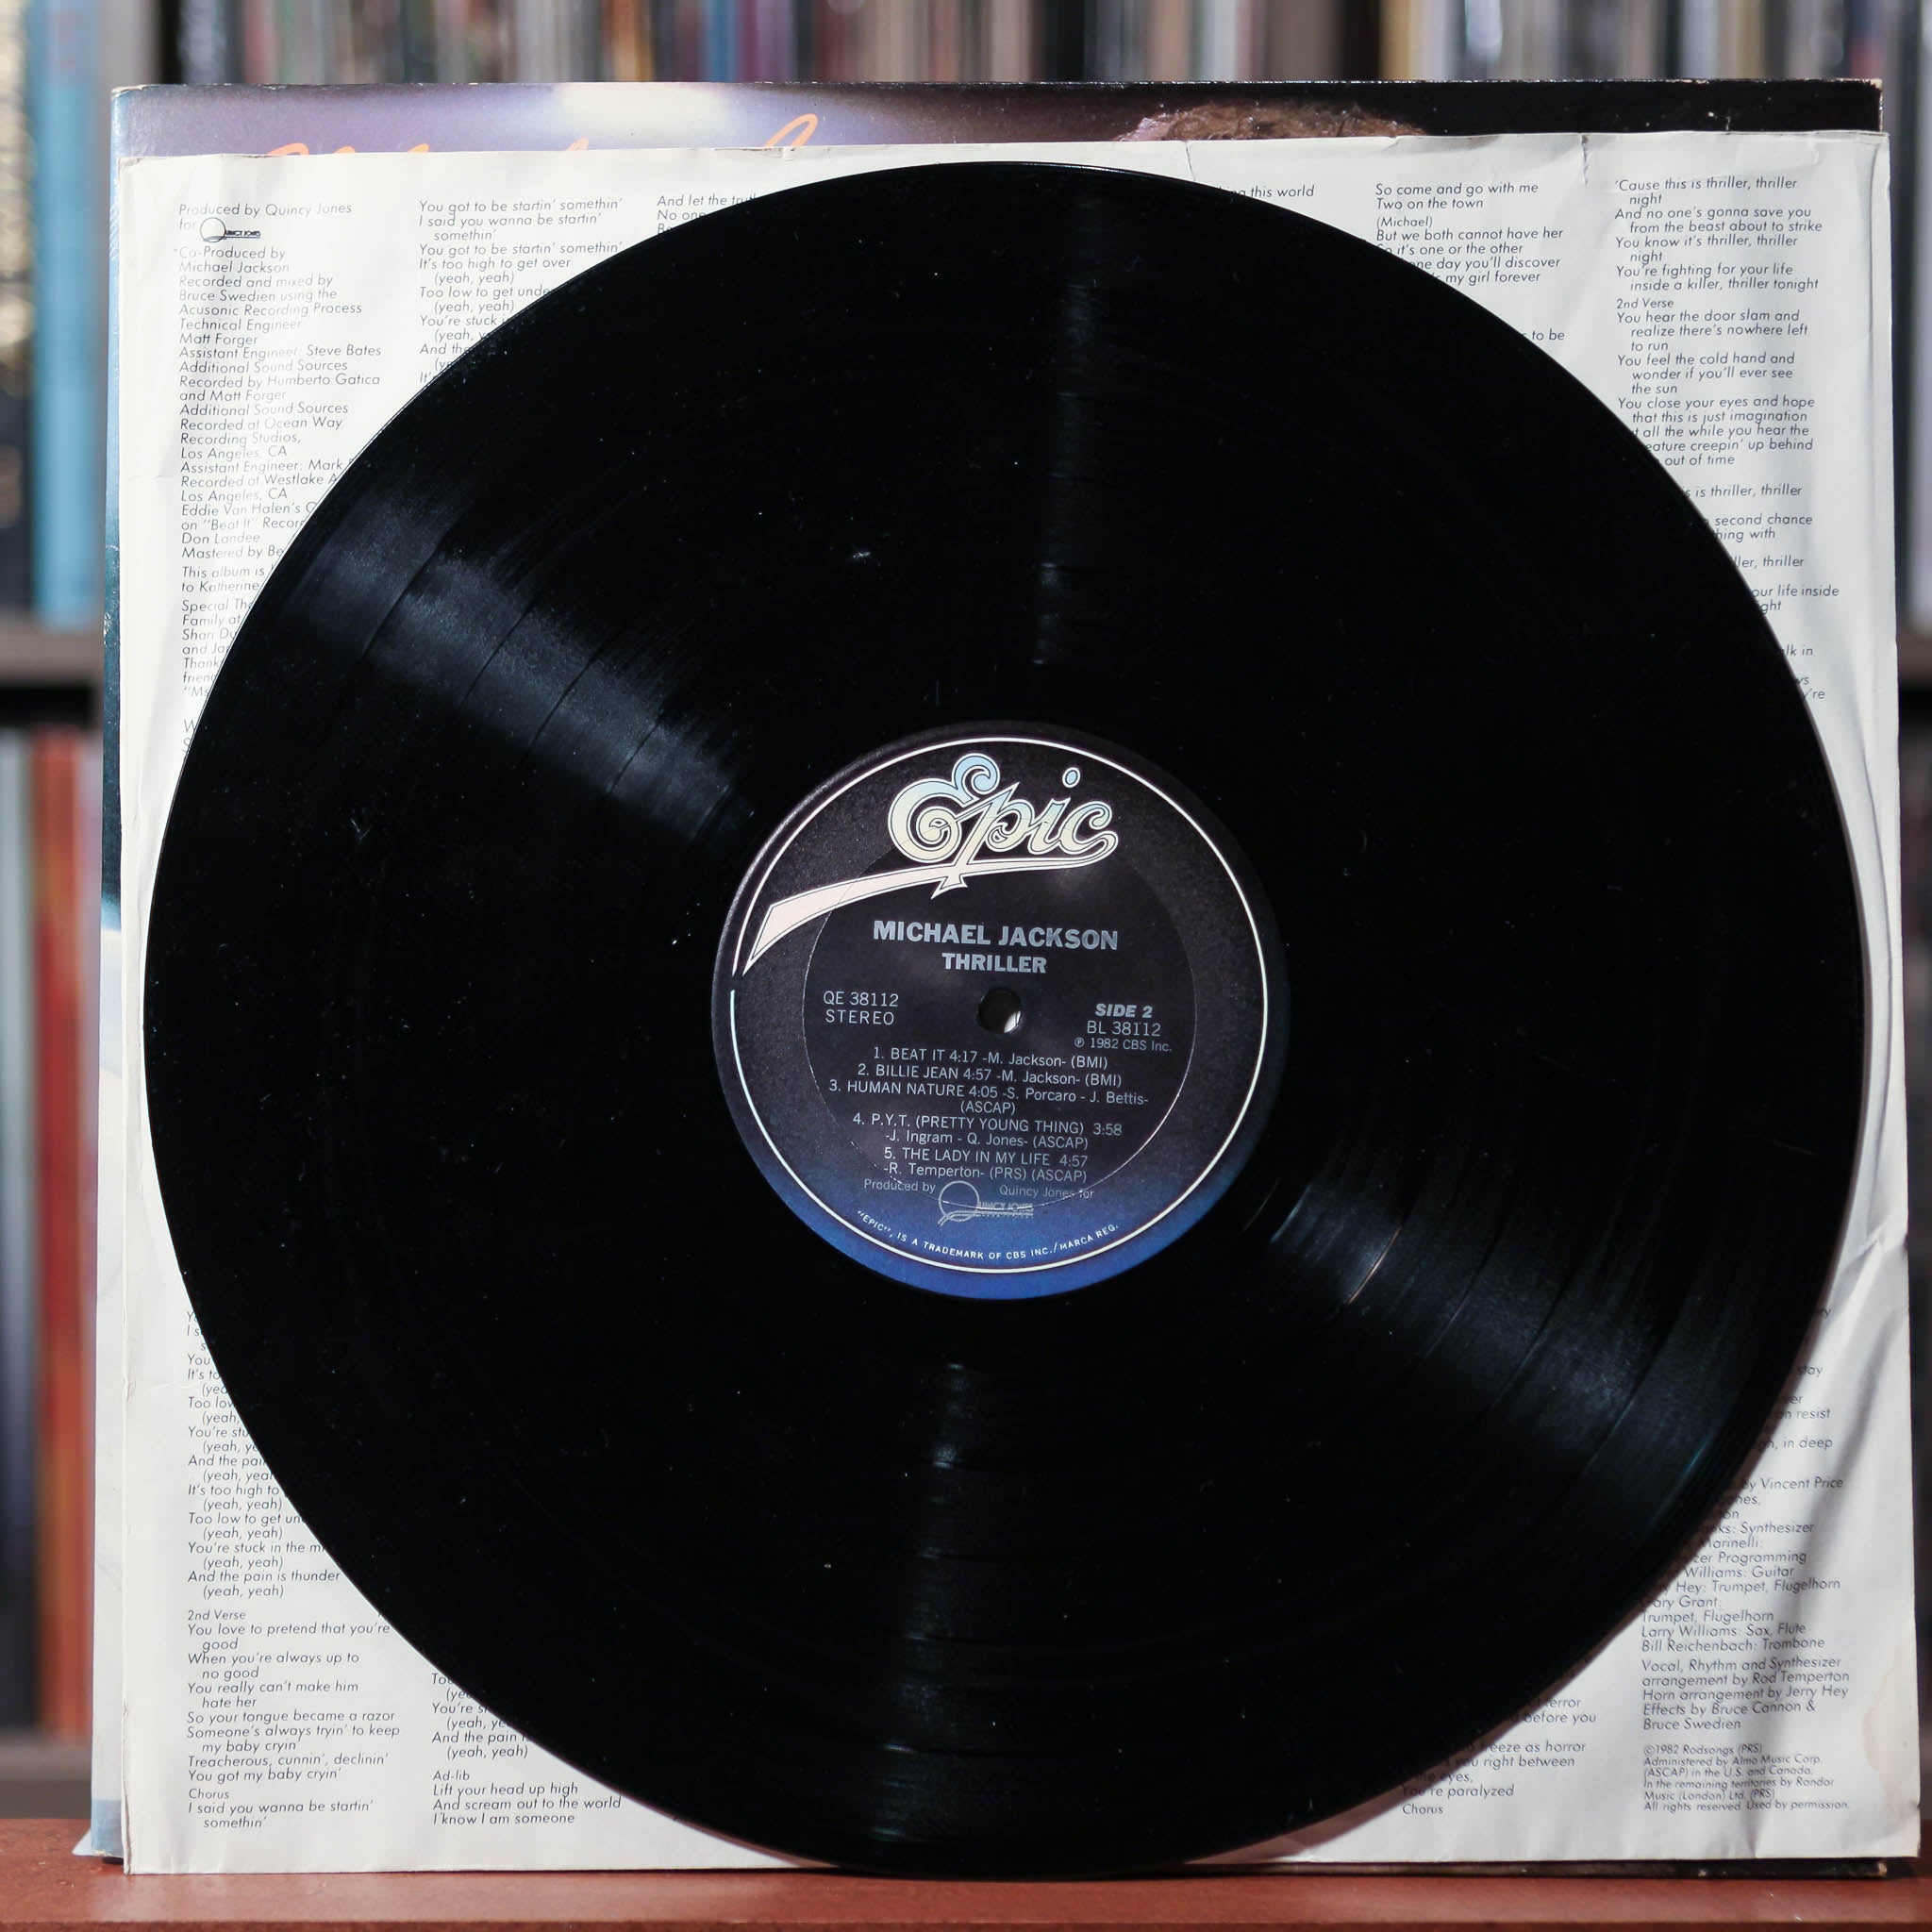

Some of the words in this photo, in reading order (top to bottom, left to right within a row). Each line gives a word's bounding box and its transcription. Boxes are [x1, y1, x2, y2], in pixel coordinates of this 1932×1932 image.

[1251, 185, 1273, 197] this
[1277, 185, 1314, 198] world
[1375, 183, 1393, 195] So
[1397, 185, 1432, 195] come
[1437, 183, 1462, 195] and
[1466, 185, 1483, 200] go
[1488, 182, 1515, 194] with
[1520, 185, 1539, 193] me
[420, 200, 444, 213] You
[449, 199, 471, 217] got
[475, 200, 487, 211] to
[491, 200, 508, 211] be
[513, 199, 556, 211] startin'
[560, 197, 623, 210] somethin'
[658, 195, 683, 207] And
[688, 194, 704, 207] let
[708, 194, 727, 206] the
[179, 203, 240, 215] Produced
[244, 204, 259, 217] by
[265, 203, 312, 217] Quincy
[315, 202, 352, 214] Jones
[1614, 208, 1642, 219] And
[1646, 208, 1663, 218] no
[1668, 207, 1703, 218] one's
[1707, 208, 1749, 220] gonna
[1754, 208, 1783, 218] save
[1789, 208, 1811, 220] you
[1376, 229, 1396, 242] But
[1400, 231, 1420, 242] we
[1424, 228, 1454, 242] both
[1458, 228, 1503, 241] cannot
[1507, 227, 1538, 240] have
[1542, 226, 1563, 239] her
[180, 261, 233, 273] Michael
[237, 260, 290, 273] Jackson
[419, 258, 438, 270] It's
[441, 258, 464, 270] too
[468, 258, 495, 273] high
[501, 258, 513, 270] to
[518, 258, 538, 273] get
[542, 258, 572, 269] over
[179, 303, 240, 316] Acusonic
[244, 302, 308, 318] Recording
[313, 301, 362, 313] Process
[180, 333, 210, 344] Matt
[215, 332, 258, 347] Forger
[1618, 398, 1642, 408] You
[1647, 398, 1681, 408] close
[1686, 398, 1714, 413] your
[1720, 397, 1748, 411] eyes
[1754, 395, 1779, 407] and
[1782, 397, 1815, 410] hope
[1715, 513, 1763, 525] second
[1768, 513, 1812, 525] chance
[182, 532, 209, 544] Don
[215, 531, 260, 543] Landee
[874, 920, 991, 944] MICHAEL
[998, 926, 1118, 950] JACKSON
[941, 952, 1047, 974] THRILLER
[824, 991, 844, 1005] QE
[850, 992, 898, 1007] 38112
[825, 1009, 894, 1024] STEREO
[1095, 1003, 1137, 1017] SIDE
[1142, 1006, 1153, 1018] 2
[1087, 1021, 1106, 1034] BL
[1111, 1021, 1161, 1037] 38112
[1091, 1038, 1118, 1049] 1982
[1124, 1040, 1146, 1050] CBS
[1152, 1041, 1172, 1052] Inc.
[874, 1047, 884, 1058] 1.
[891, 1048, 926, 1060] BEAT
[932, 1049, 945, 1061] IT
[949, 1050, 977, 1062] 4:17
[983, 1052, 1003, 1064] -M.
[1008, 1053, 1066, 1067] Jackson-
[1072, 1056, 1108, 1070] (BMI)
[858, 1064, 869, 1075] 2.
[876, 1064, 919, 1077] BILLIE
[924, 1067, 958, 1079] JEAN
[963, 1069, 991, 1081] 4:57
[996, 1070, 1017, 1082] -M.
[1023, 1071, 1080, 1084] Jackson-
[1085, 1074, 1122, 1088] (BMI)
[829, 1079, 841, 1091] 3.
[847, 1081, 901, 1094] HUMAN
[908, 1084, 964, 1096] NATURE
[969, 1087, 997, 1098] 4:05
[1003, 1087, 1019, 1099] -S.
[1026, 1088, 1076, 1102] Porcaro
[1091, 1091, 1100, 1102] J.
[1107, 1092, 1149, 1105] Bettis-
[960, 1102, 1016, 1115] (ASCAP)
[853, 1112, 864, 1124] 4.
[872, 1113, 910, 1126] P.Y.T.
[916, 1115, 974, 1129] (PRETTY
[980, 1118, 1028, 1131] YOUNG
[1035, 1121, 1084, 1135] THING)
[1093, 1123, 1123, 1136] 3:58
[885, 1130, 899, 1141] -J.
[907, 1130, 952, 1144] Ingram
[967, 1133, 980, 1144] Q.
[986, 1134, 1027, 1147] Jones-
[1033, 1136, 1088, 1150] (ASCAP)
[884, 1147, 895, 1159] 5.
[902, 1148, 929, 1160] THE
[935, 1149, 970, 1161] LADY
[976, 1152, 990, 1162] IN
[995, 1152, 1016, 1163] MY
[1021, 1153, 1049, 1166] LIFE
[1059, 1155, 1088, 1167] 4:57
[884, 1162, 901, 1174] -R.
[908, 1163, 984, 1178] Temperton-
[991, 1168, 1026, 1180] (PRS)
[1032, 1169, 1087, 1182] (ASCAP)
[864, 1178, 918, 1191] Produced
[923, 1182, 936, 1194] by
[1000, 1185, 1038, 1198] Quincy
[1043, 1187, 1075, 1197] Jones
[1079, 1190, 1094, 1198] for
[897, 1232, 907, 1241] IS
[924, 1241, 983, 1259] TRADEMARK
[1007, 1251, 1026, 1259] CBS
[1096, 1224, 1119, 1238] REG.
[1641, 1641, 1662, 1652] Bill
[1762, 1639, 1825, 1650] Trombone
[188, 1725, 260, 1739] Someone's
[265, 1724, 311, 1740] always
[316, 1724, 347, 1738] tryin'
[353, 1725, 364, 1735] to
[369, 1724, 400, 1739] keep
[1643, 1719, 1680, 1730] Bruce
[1684, 1719, 1740, 1730] Swedien
[433, 1796, 459, 1810] And
[465, 1799, 511, 1810] scream
[517, 1798, 537, 1809] out
[542, 1798, 554, 1808] to
[559, 1796, 578, 1808] the
[584, 1797, 621, 1808] world
[1402, 1804, 1443, 1814] Chorus
